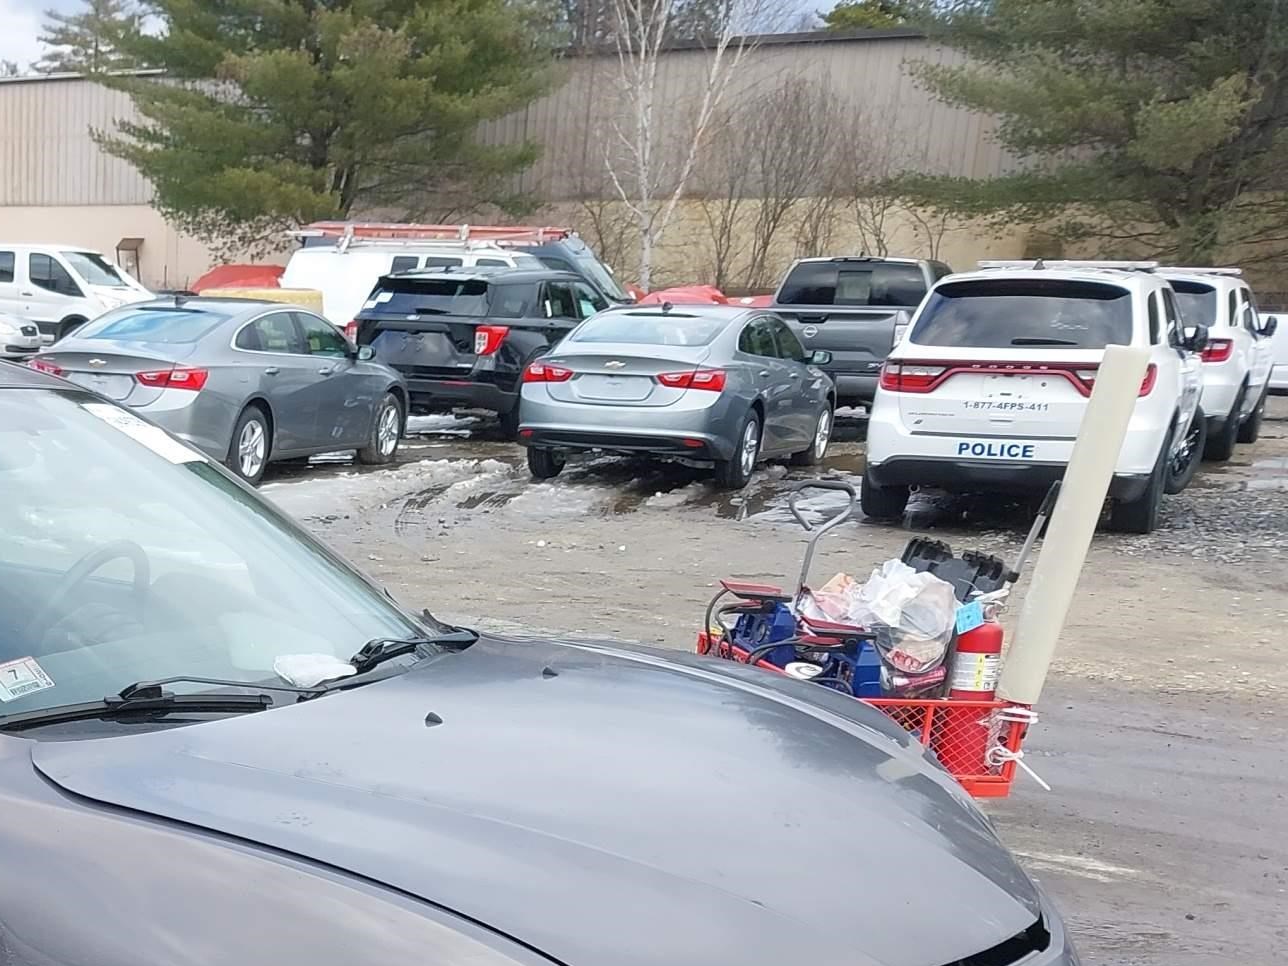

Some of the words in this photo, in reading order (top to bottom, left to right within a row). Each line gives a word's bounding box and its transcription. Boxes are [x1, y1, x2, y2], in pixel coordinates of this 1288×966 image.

[962, 401, 1050, 412] 1-877-4FPS-411
[957, 442, 1035, 458] POLICE
[7, 668, 18, 681] 7
